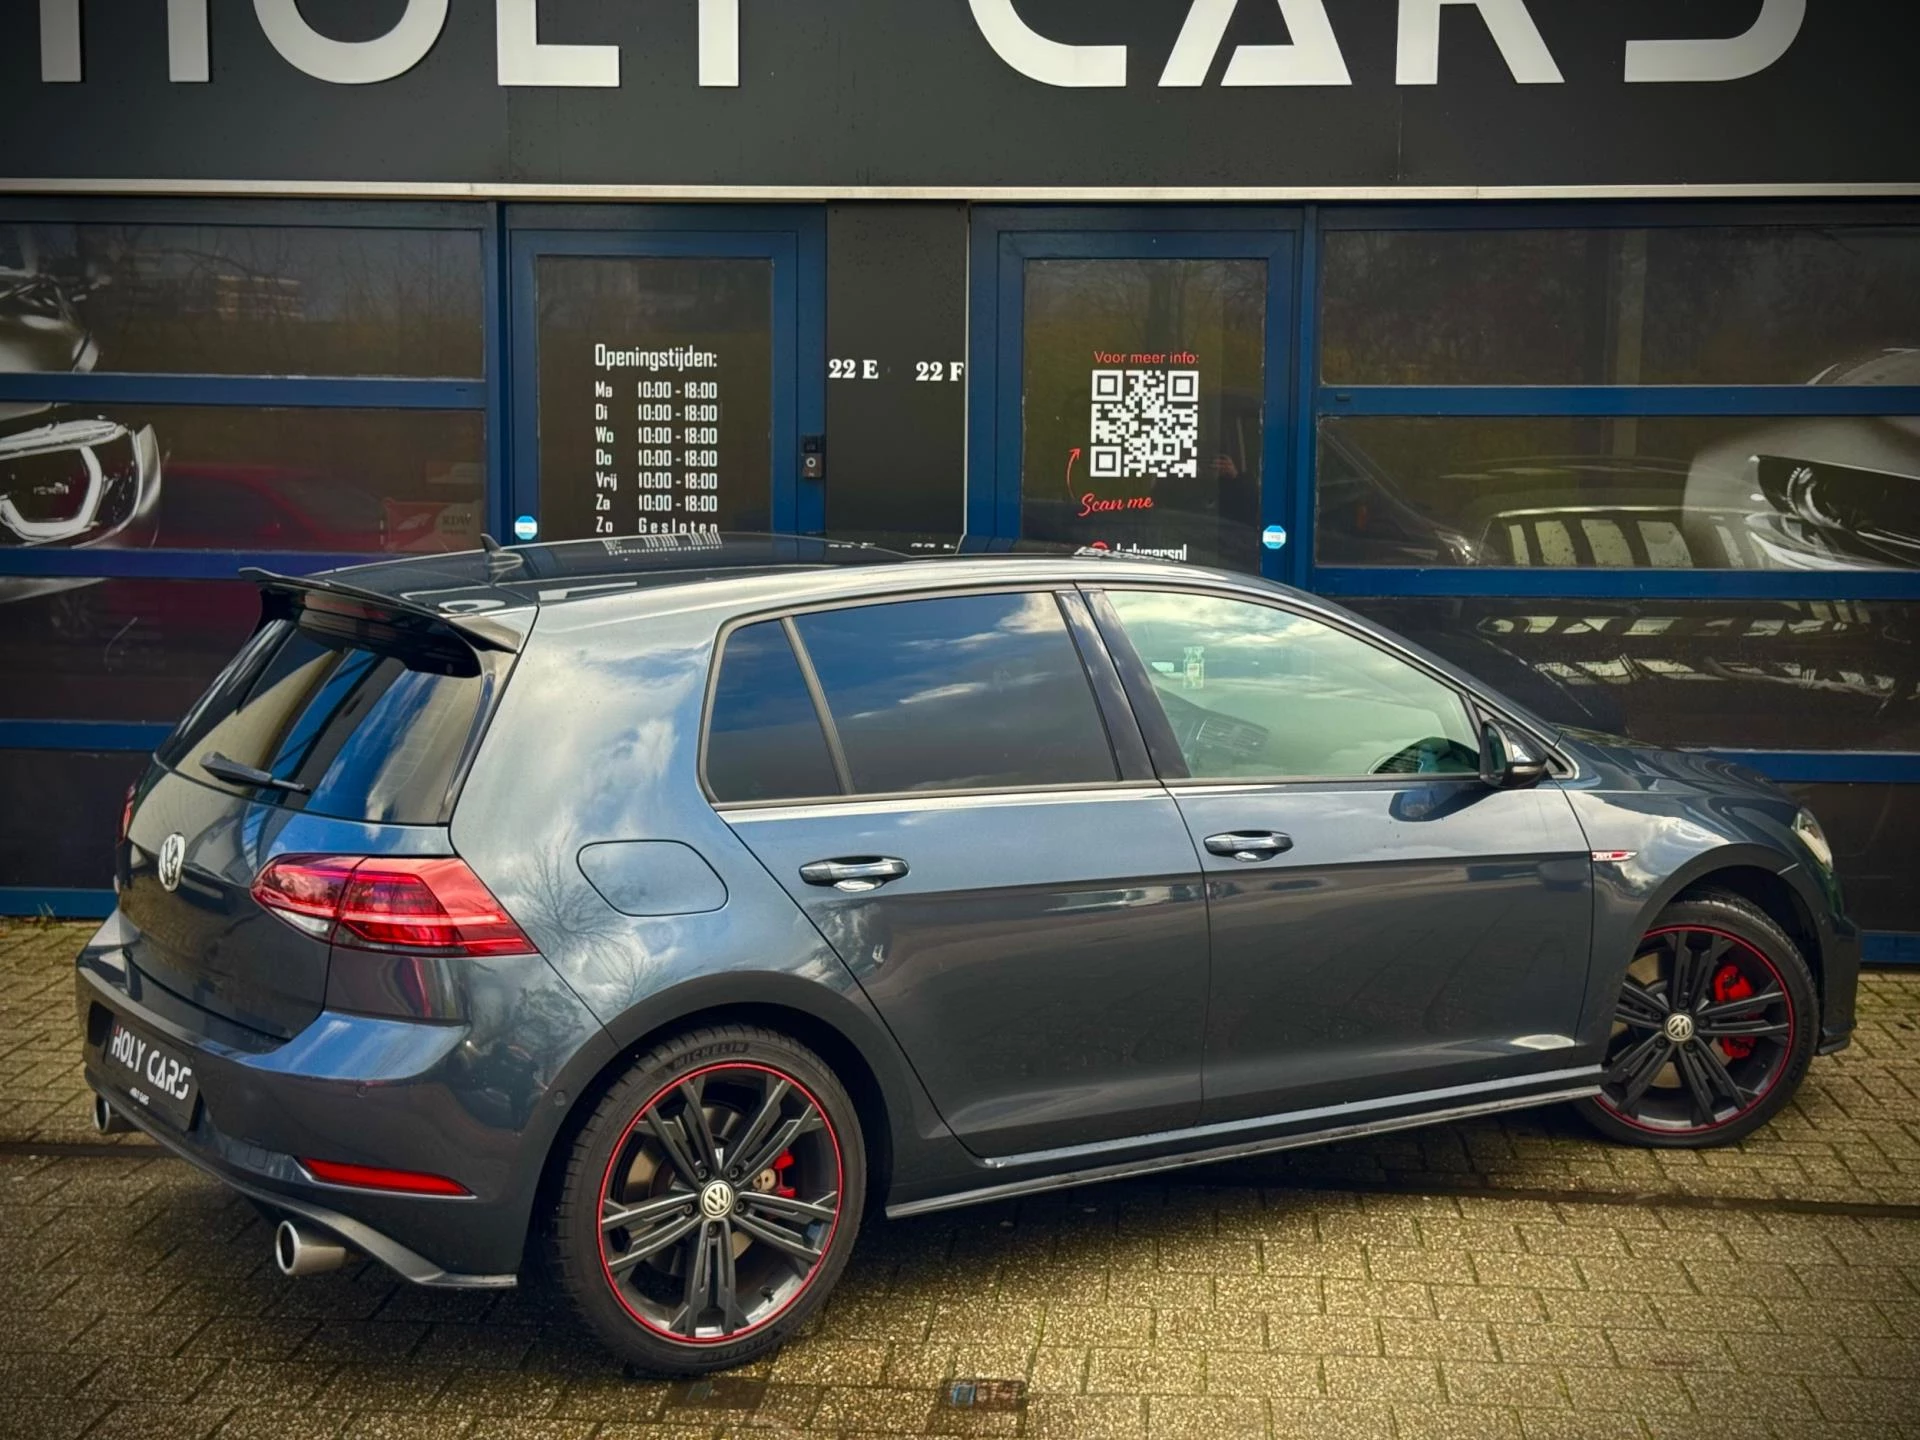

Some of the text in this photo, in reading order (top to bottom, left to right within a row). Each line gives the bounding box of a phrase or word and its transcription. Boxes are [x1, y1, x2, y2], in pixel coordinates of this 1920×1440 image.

[595, 344, 717, 371] Openingstijden:
[1095, 351, 1198, 363] Voor meer info:
[829, 359, 878, 379] 22 E
[916, 362, 964, 381] 22 F
[596, 381, 612, 397] Ma
[638, 382, 671, 398] 10:00
[685, 382, 717, 398] 18:00
[596, 404, 607, 420] Di
[638, 404, 671, 421] 10:00
[685, 405, 717, 421] 18:00
[596, 427, 613, 443] Wo
[638, 427, 671, 443] 10:00
[685, 428, 717, 444] 18:00
[596, 449, 611, 465] Do
[639, 450, 671, 466] 10:00
[685, 450, 717, 466] 18:00
[596, 472, 617, 491] Vrij
[639, 472, 671, 488] 10:00
[685, 473, 717, 489] 18:00
[596, 494, 610, 510] Za
[639, 495, 671, 511] 10:00
[685, 495, 717, 511] 18:00
[1078, 493, 1153, 516] Scan me
[596, 516, 718, 534] Zo Gesloten
[111, 1026, 192, 1101] HOLY CARS
